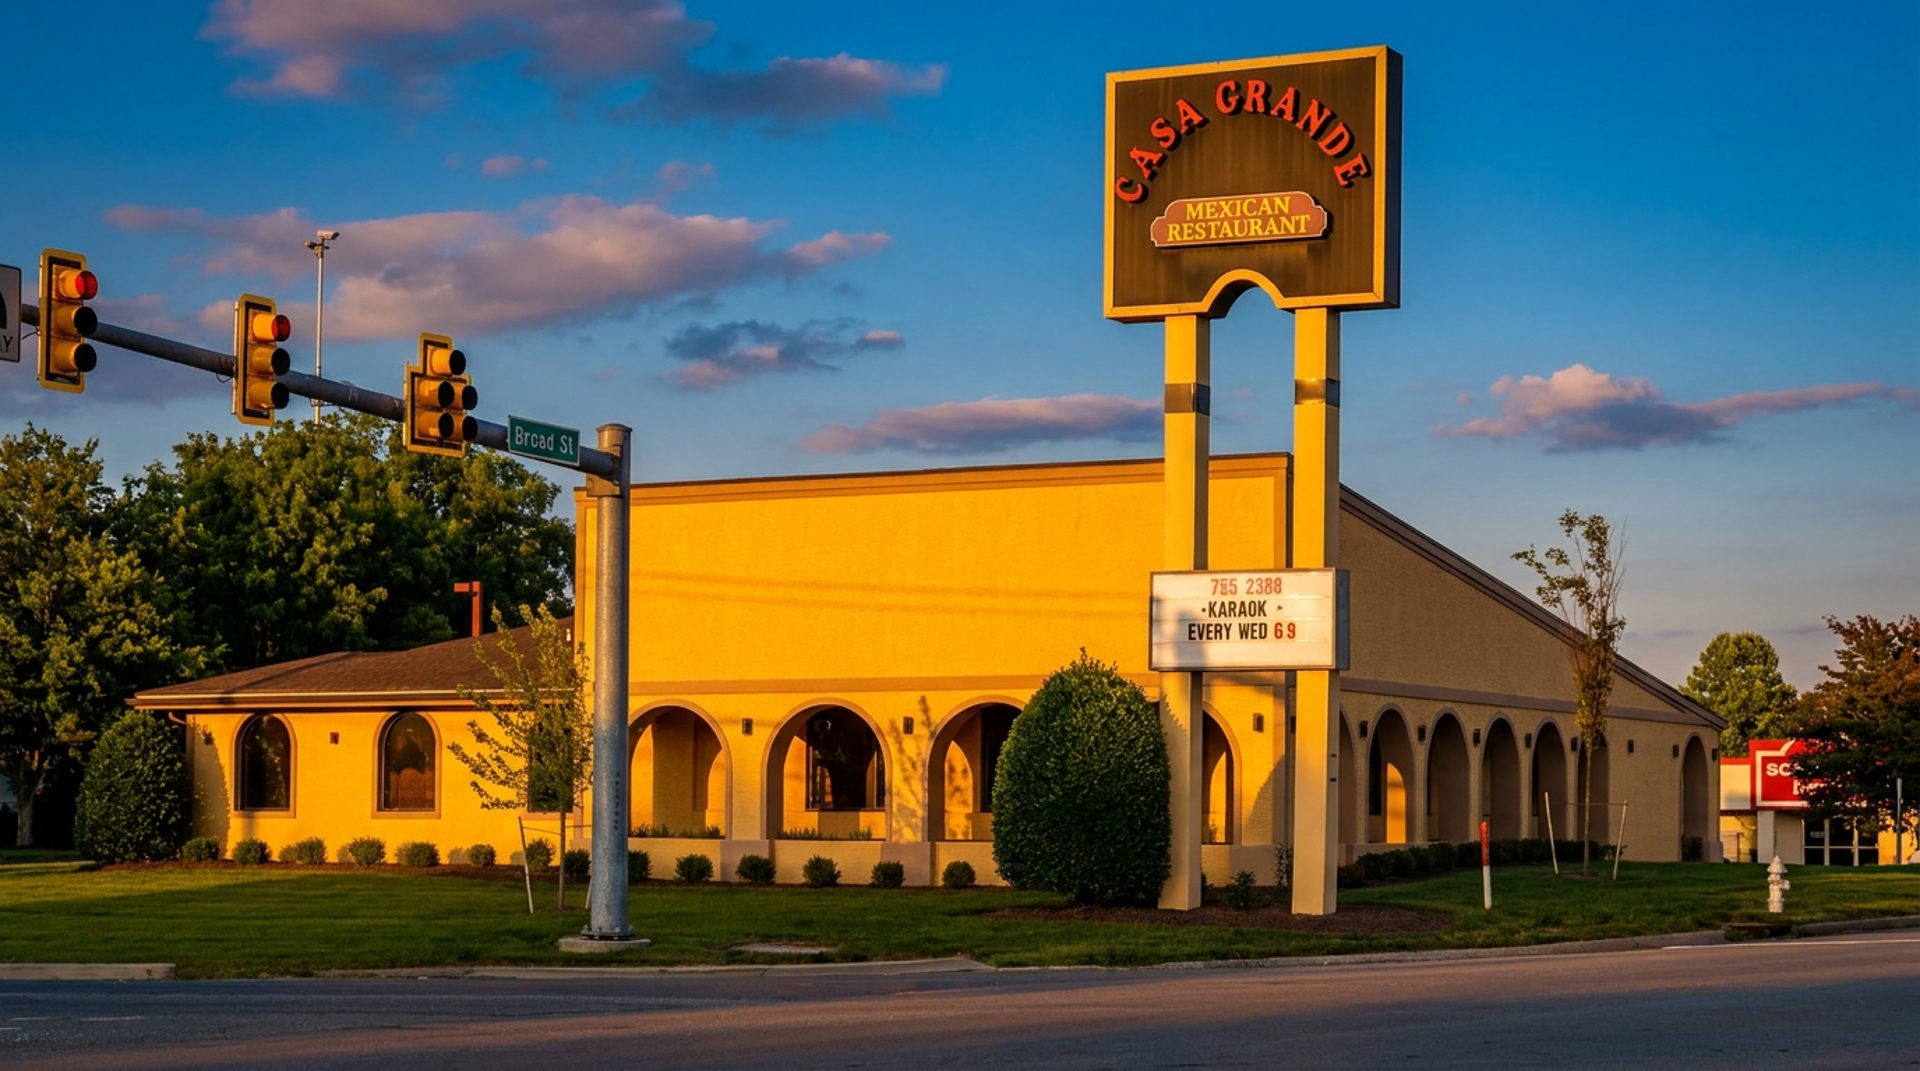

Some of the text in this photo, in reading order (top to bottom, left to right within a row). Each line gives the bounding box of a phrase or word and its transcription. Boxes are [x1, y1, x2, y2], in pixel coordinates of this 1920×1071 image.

[1115, 79, 1369, 202] CASA GRANDE
[1185, 196, 1291, 221] MEXICAN
[1167, 215, 1310, 242] RESTAURANT
[560, 435, 574, 455] St
[1246, 577, 1282, 595] 2388
[1188, 623, 1232, 641] EVERY
[1238, 622, 1268, 640] WED
